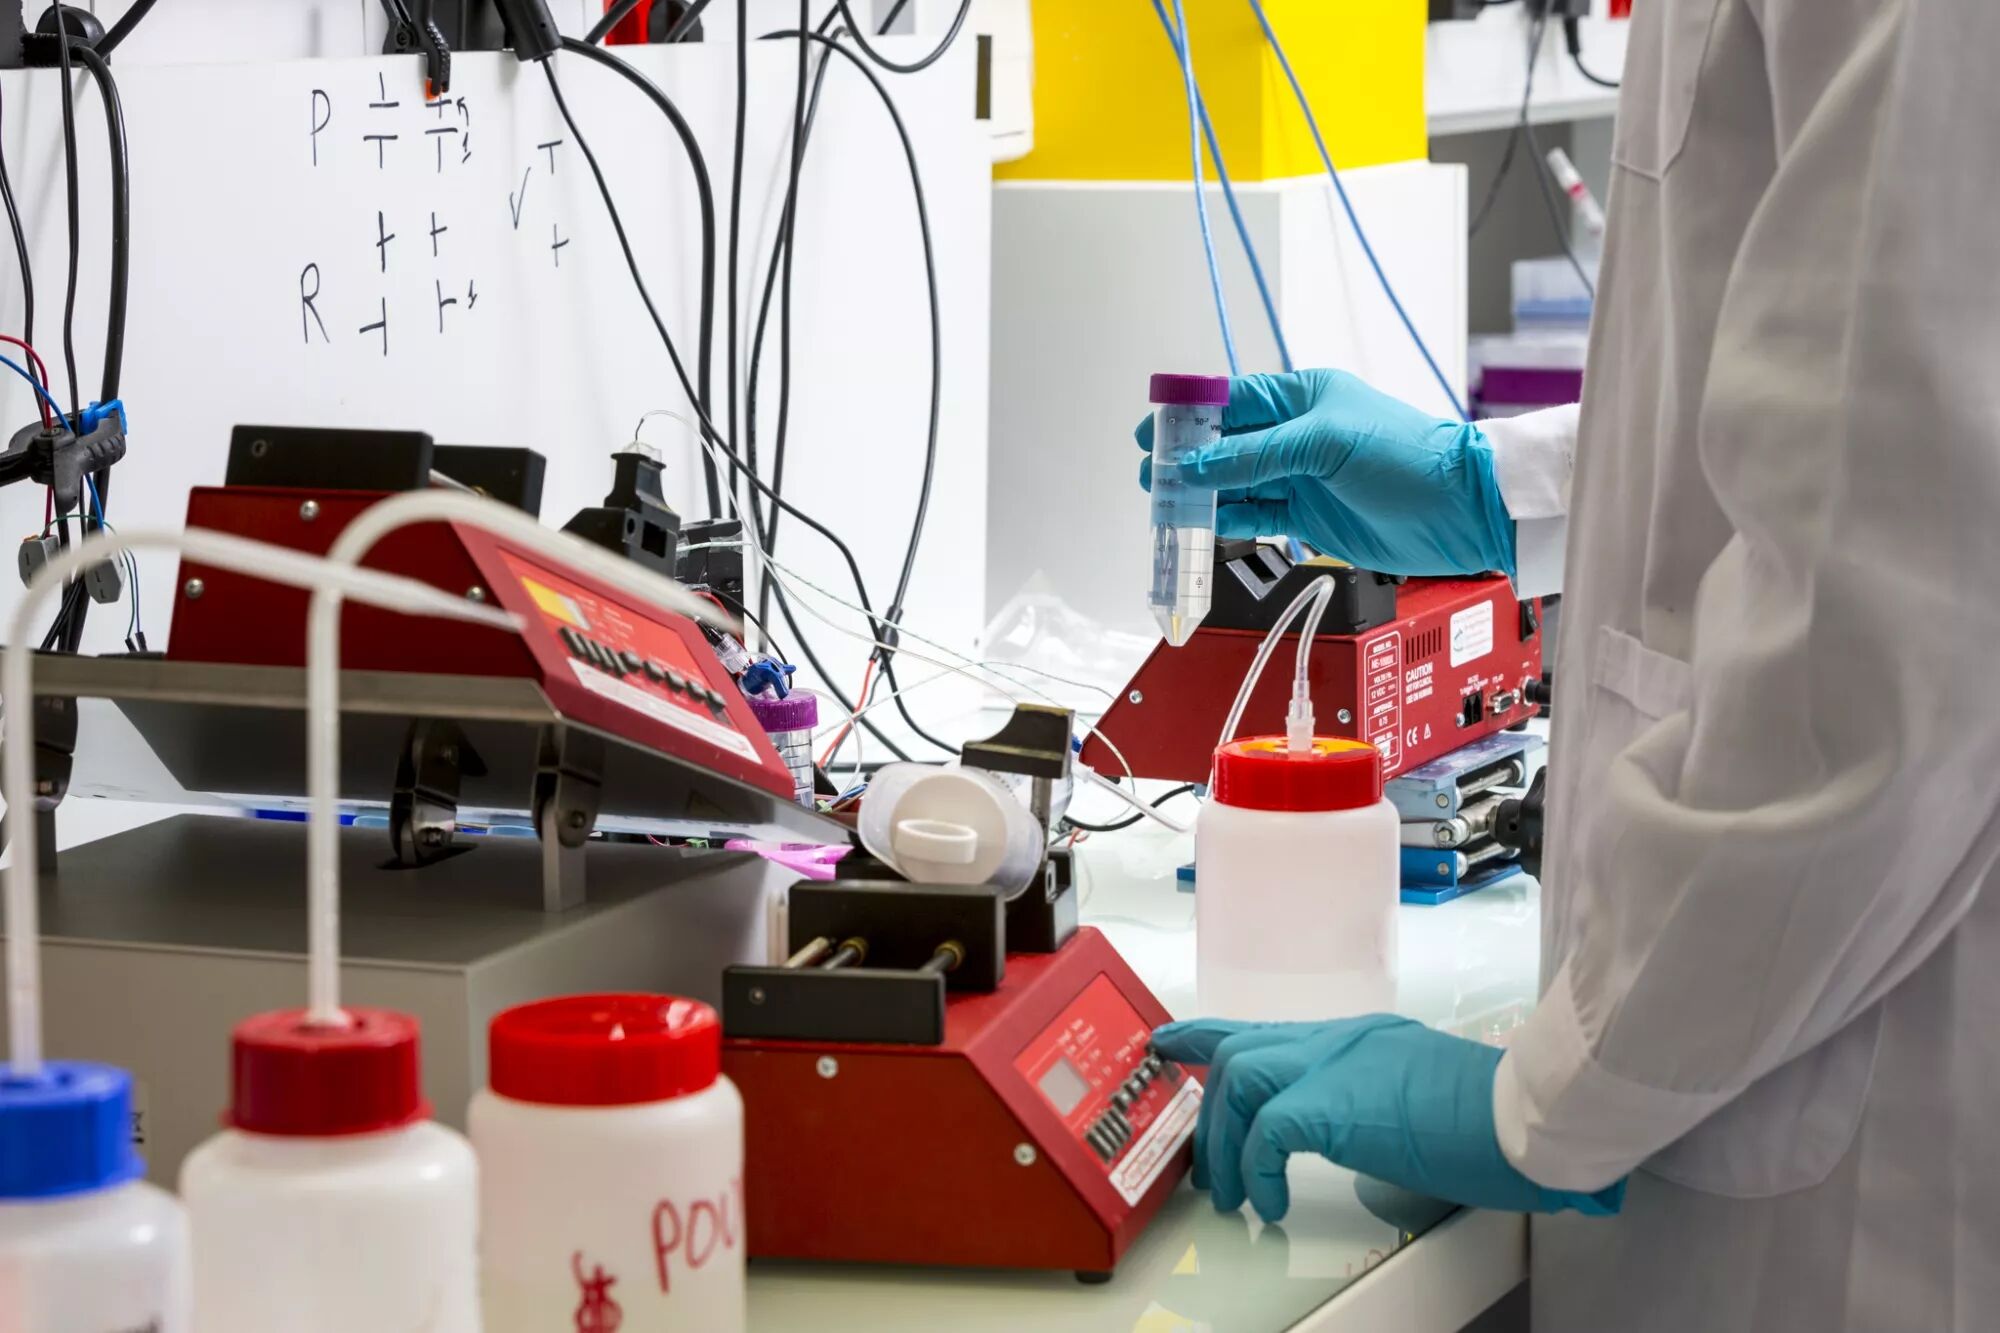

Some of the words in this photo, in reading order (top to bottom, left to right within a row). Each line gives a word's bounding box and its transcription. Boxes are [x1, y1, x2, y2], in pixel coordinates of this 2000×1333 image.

[310, 89, 331, 167] P
[300, 262, 331, 344] R
[1405, 661, 1433, 683] CAUTION
